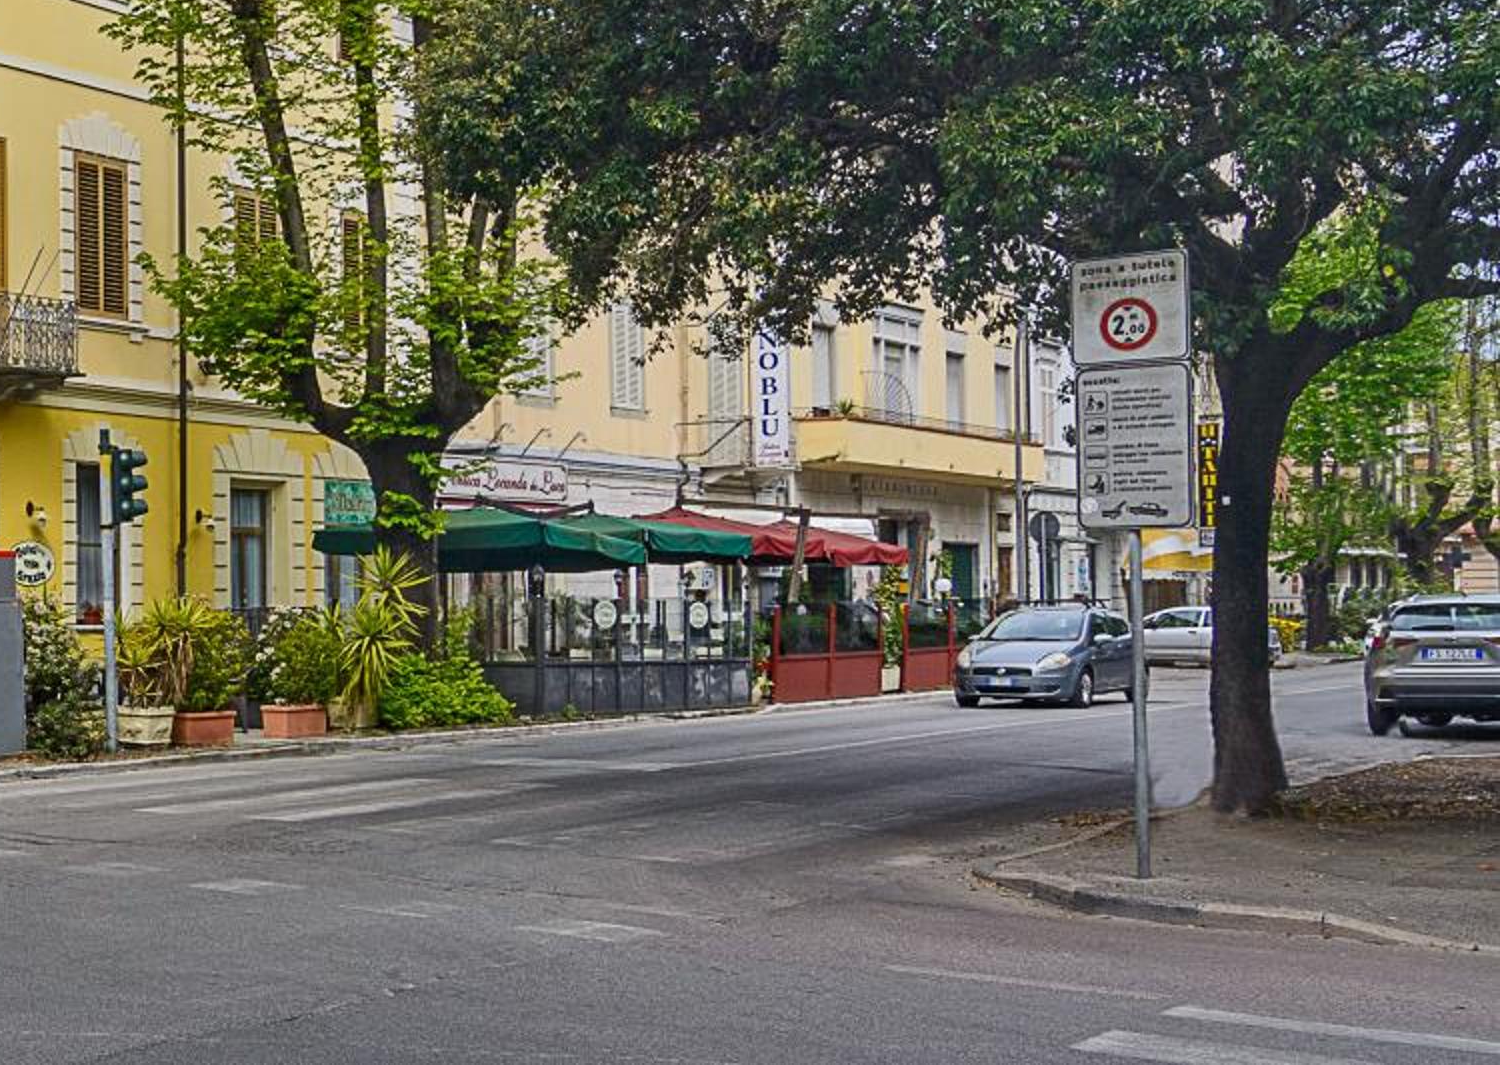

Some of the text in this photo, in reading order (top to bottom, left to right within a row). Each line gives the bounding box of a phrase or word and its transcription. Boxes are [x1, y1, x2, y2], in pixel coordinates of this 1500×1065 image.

[1081, 266, 1111, 277] zona
[1132, 258, 1175, 271] tutela
[1080, 273, 1177, 292] paesaggistica
